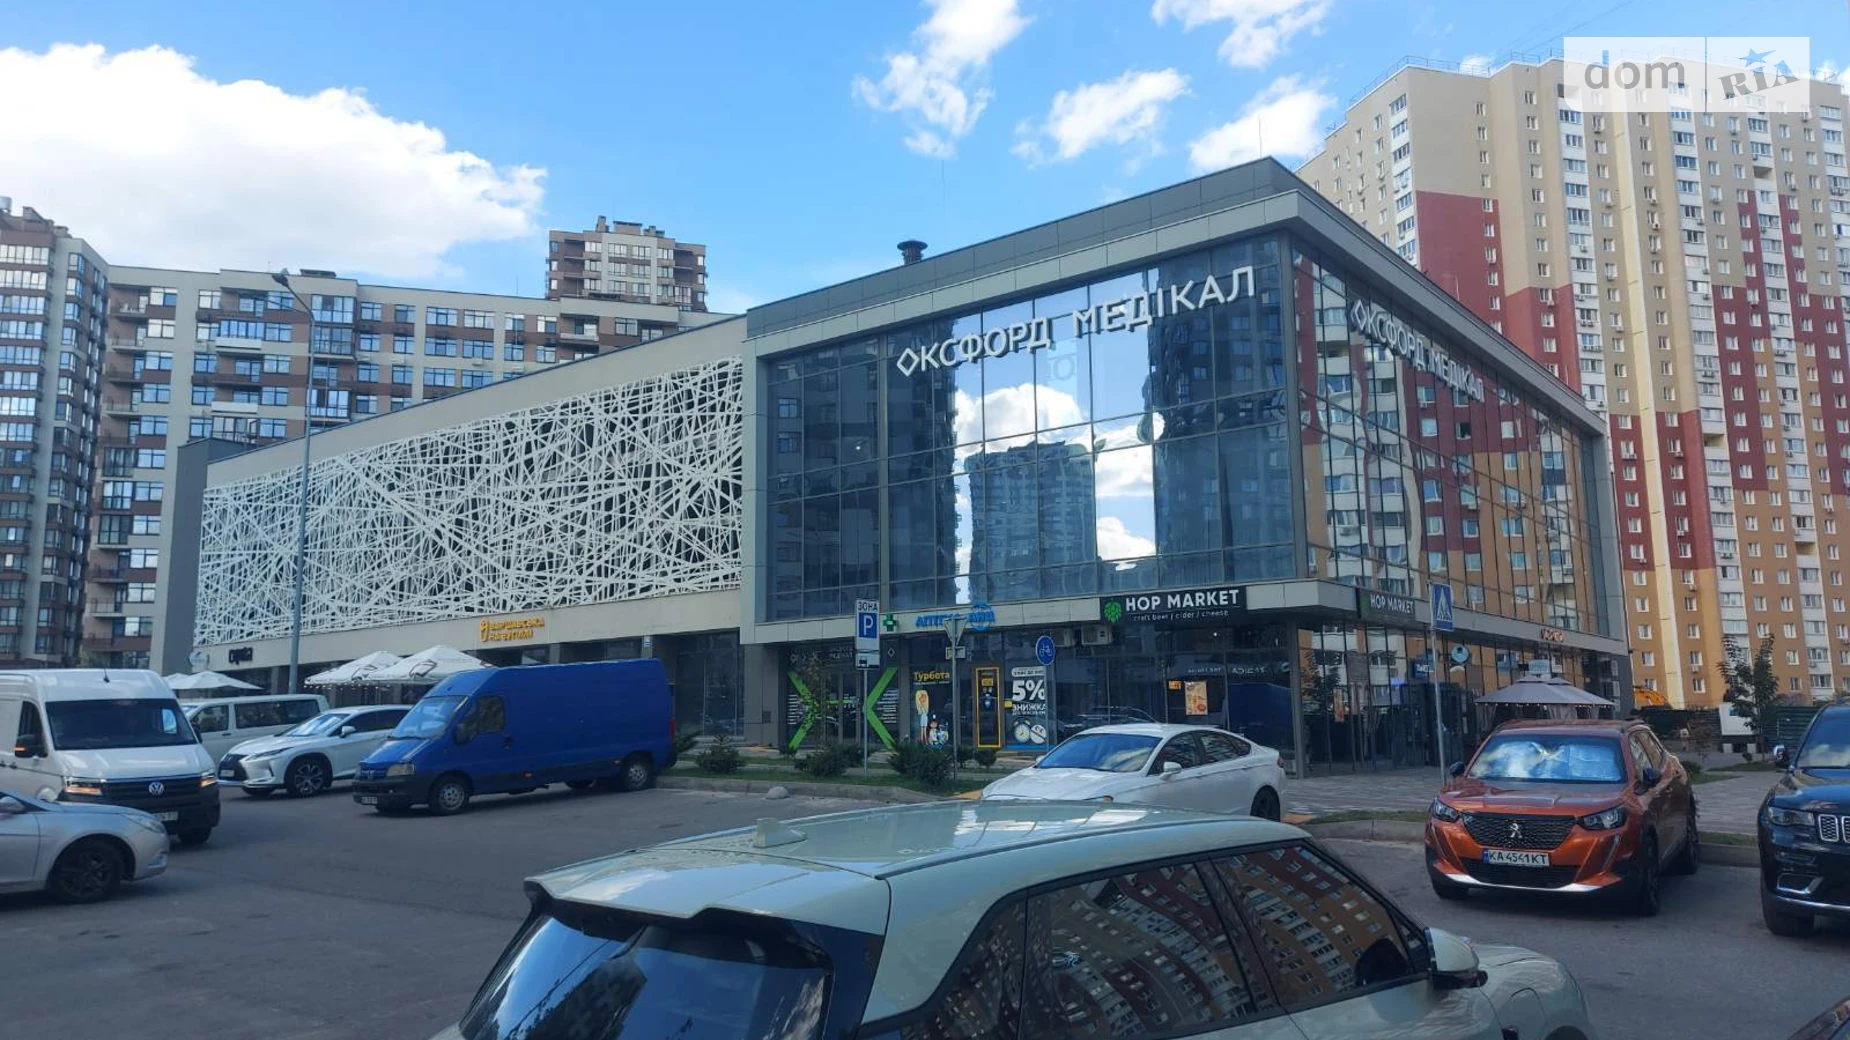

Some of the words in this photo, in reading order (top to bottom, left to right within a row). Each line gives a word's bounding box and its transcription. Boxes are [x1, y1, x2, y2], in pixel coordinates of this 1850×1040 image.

[896, 316, 1053, 377] ОКСФОРД
[1072, 265, 1256, 339] МЕДІКАЛ
[1354, 299, 1427, 372] ОКСФОРД
[1428, 347, 1485, 403] МЕДІКАЛ
[857, 601, 878, 612] ЗОНА
[1126, 596, 1161, 612] HOP
[1167, 589, 1240, 609] MARKET
[1370, 594, 1386, 609] HOP
[913, 670, 950, 682] Турбота
